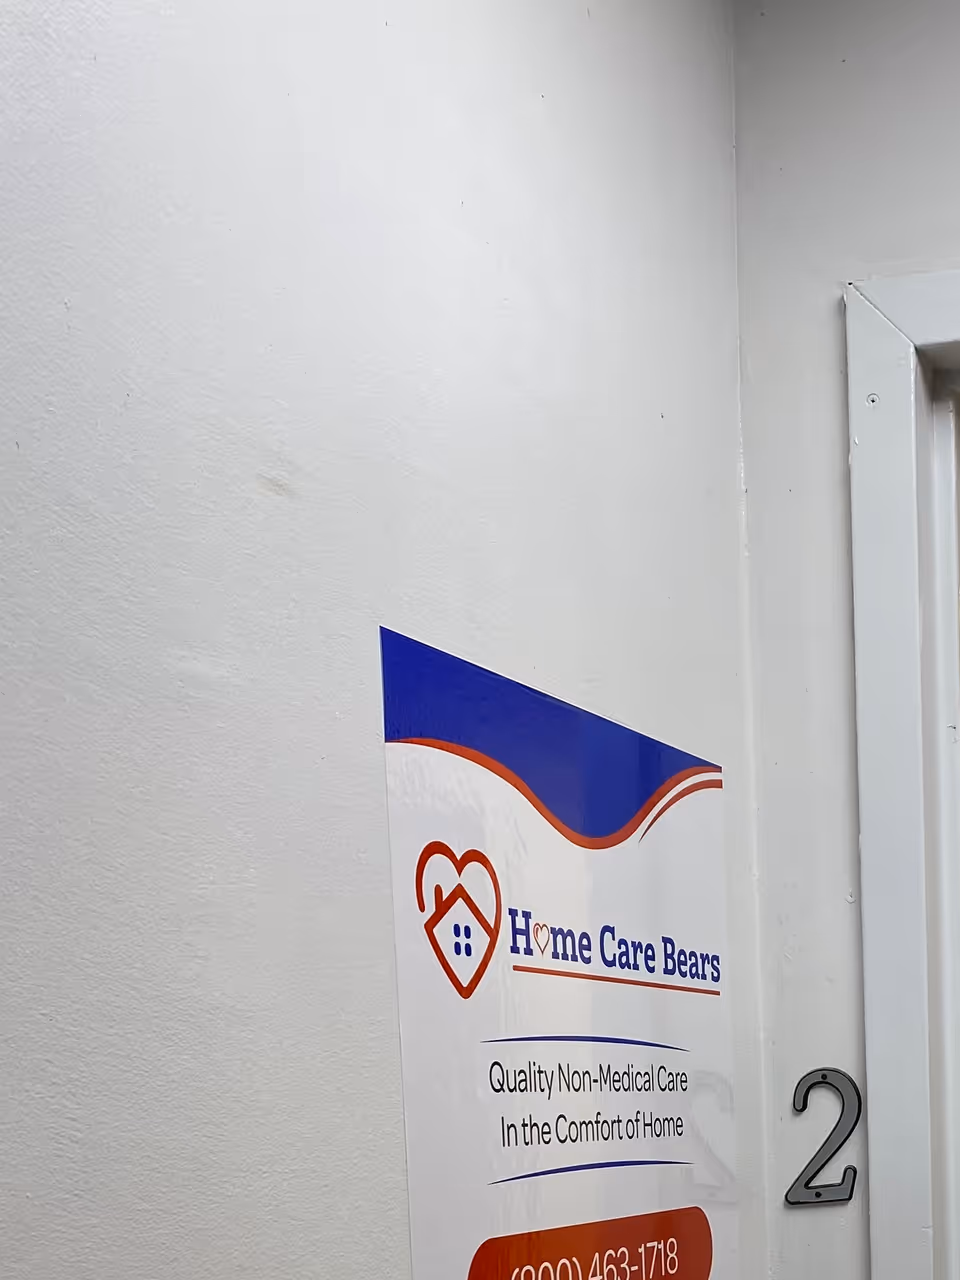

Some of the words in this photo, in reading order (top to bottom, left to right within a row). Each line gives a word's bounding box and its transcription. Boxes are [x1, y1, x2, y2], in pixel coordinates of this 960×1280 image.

[600, 924, 656, 974] Care
[661, 935, 721, 983] Bears
[489, 1060, 554, 1100] Quality
[558, 1063, 655, 1093] Non-Medical
[657, 1065, 688, 1092] Care
[501, 1116, 518, 1147] In
[521, 1114, 551, 1146] the
[555, 1111, 623, 1144] Comfort
[625, 1110, 641, 1140] of
[642, 1111, 684, 1138] Home
[785, 1066, 862, 1207] 2
